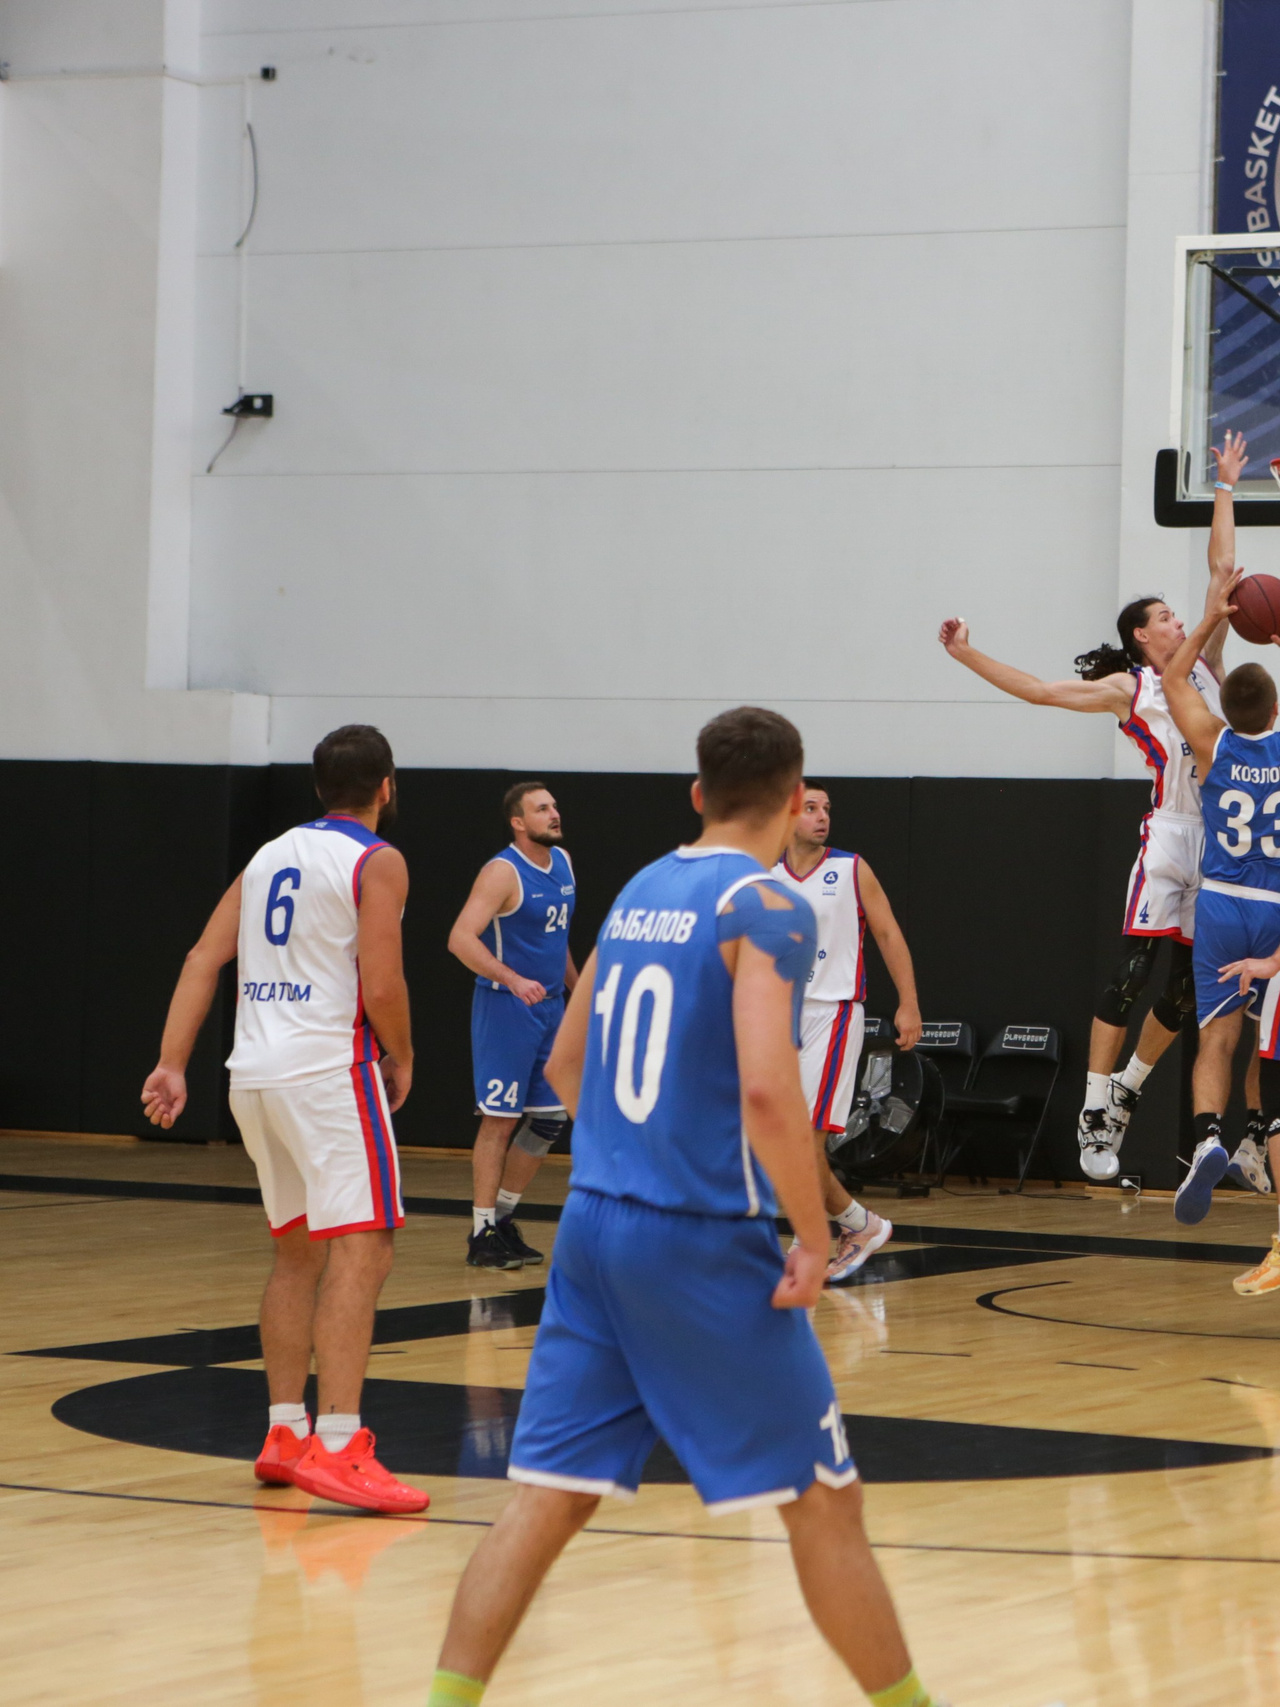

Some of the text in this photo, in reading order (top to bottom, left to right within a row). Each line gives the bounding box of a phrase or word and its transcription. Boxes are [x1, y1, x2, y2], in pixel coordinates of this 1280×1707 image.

[264, 867, 301, 946] 6
[545, 903, 568, 933] 24
[1139, 899, 1149, 924] 4
[595, 964, 674, 1124] 10
[485, 1079, 519, 1108] 24
